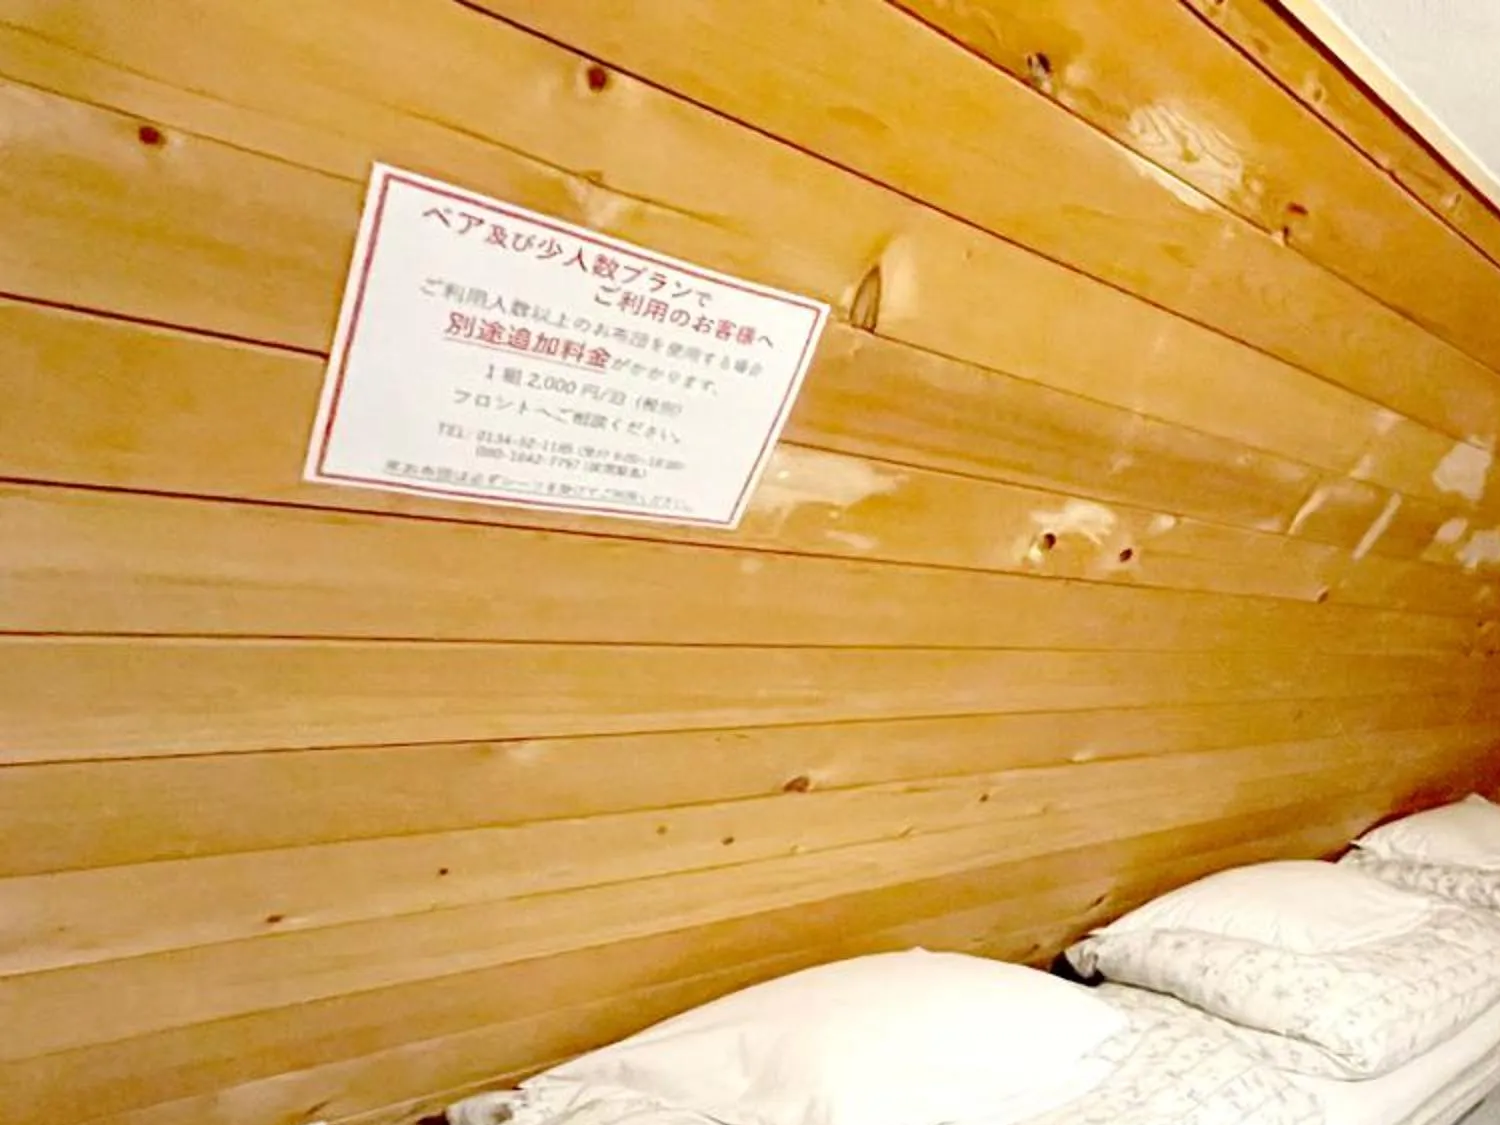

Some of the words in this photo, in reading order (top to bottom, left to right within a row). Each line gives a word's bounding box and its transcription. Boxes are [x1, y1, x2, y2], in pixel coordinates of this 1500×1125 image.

[594, 284, 775, 349] ご利用のお客様へ
